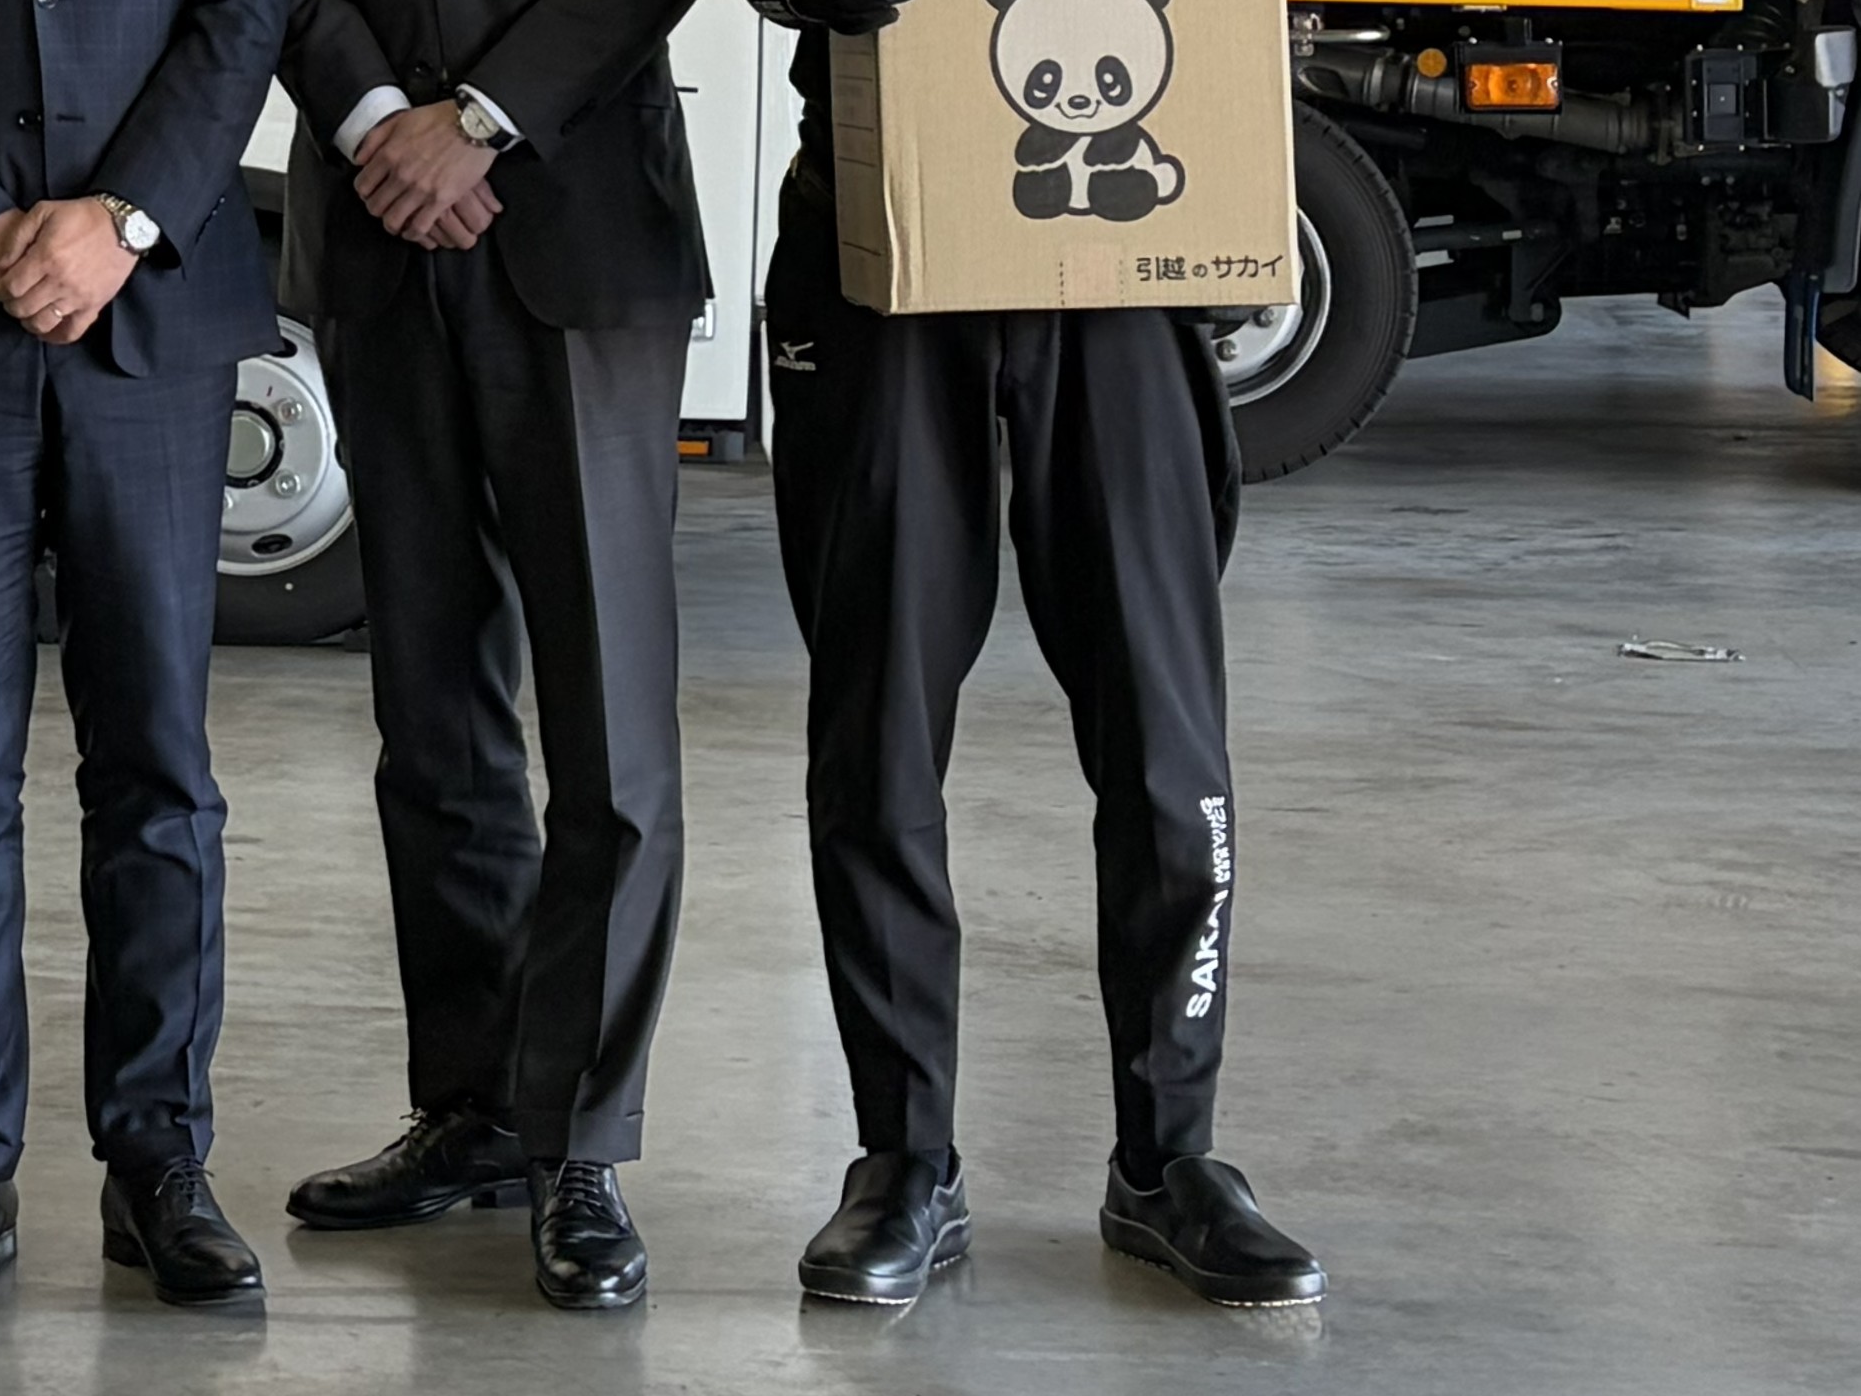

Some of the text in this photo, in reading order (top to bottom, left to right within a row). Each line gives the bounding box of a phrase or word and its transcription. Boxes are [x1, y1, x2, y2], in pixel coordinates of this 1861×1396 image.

[1136, 254, 1284, 282] 引越のサカイ
[947, 1299, 1013, 1316] SAKAI
